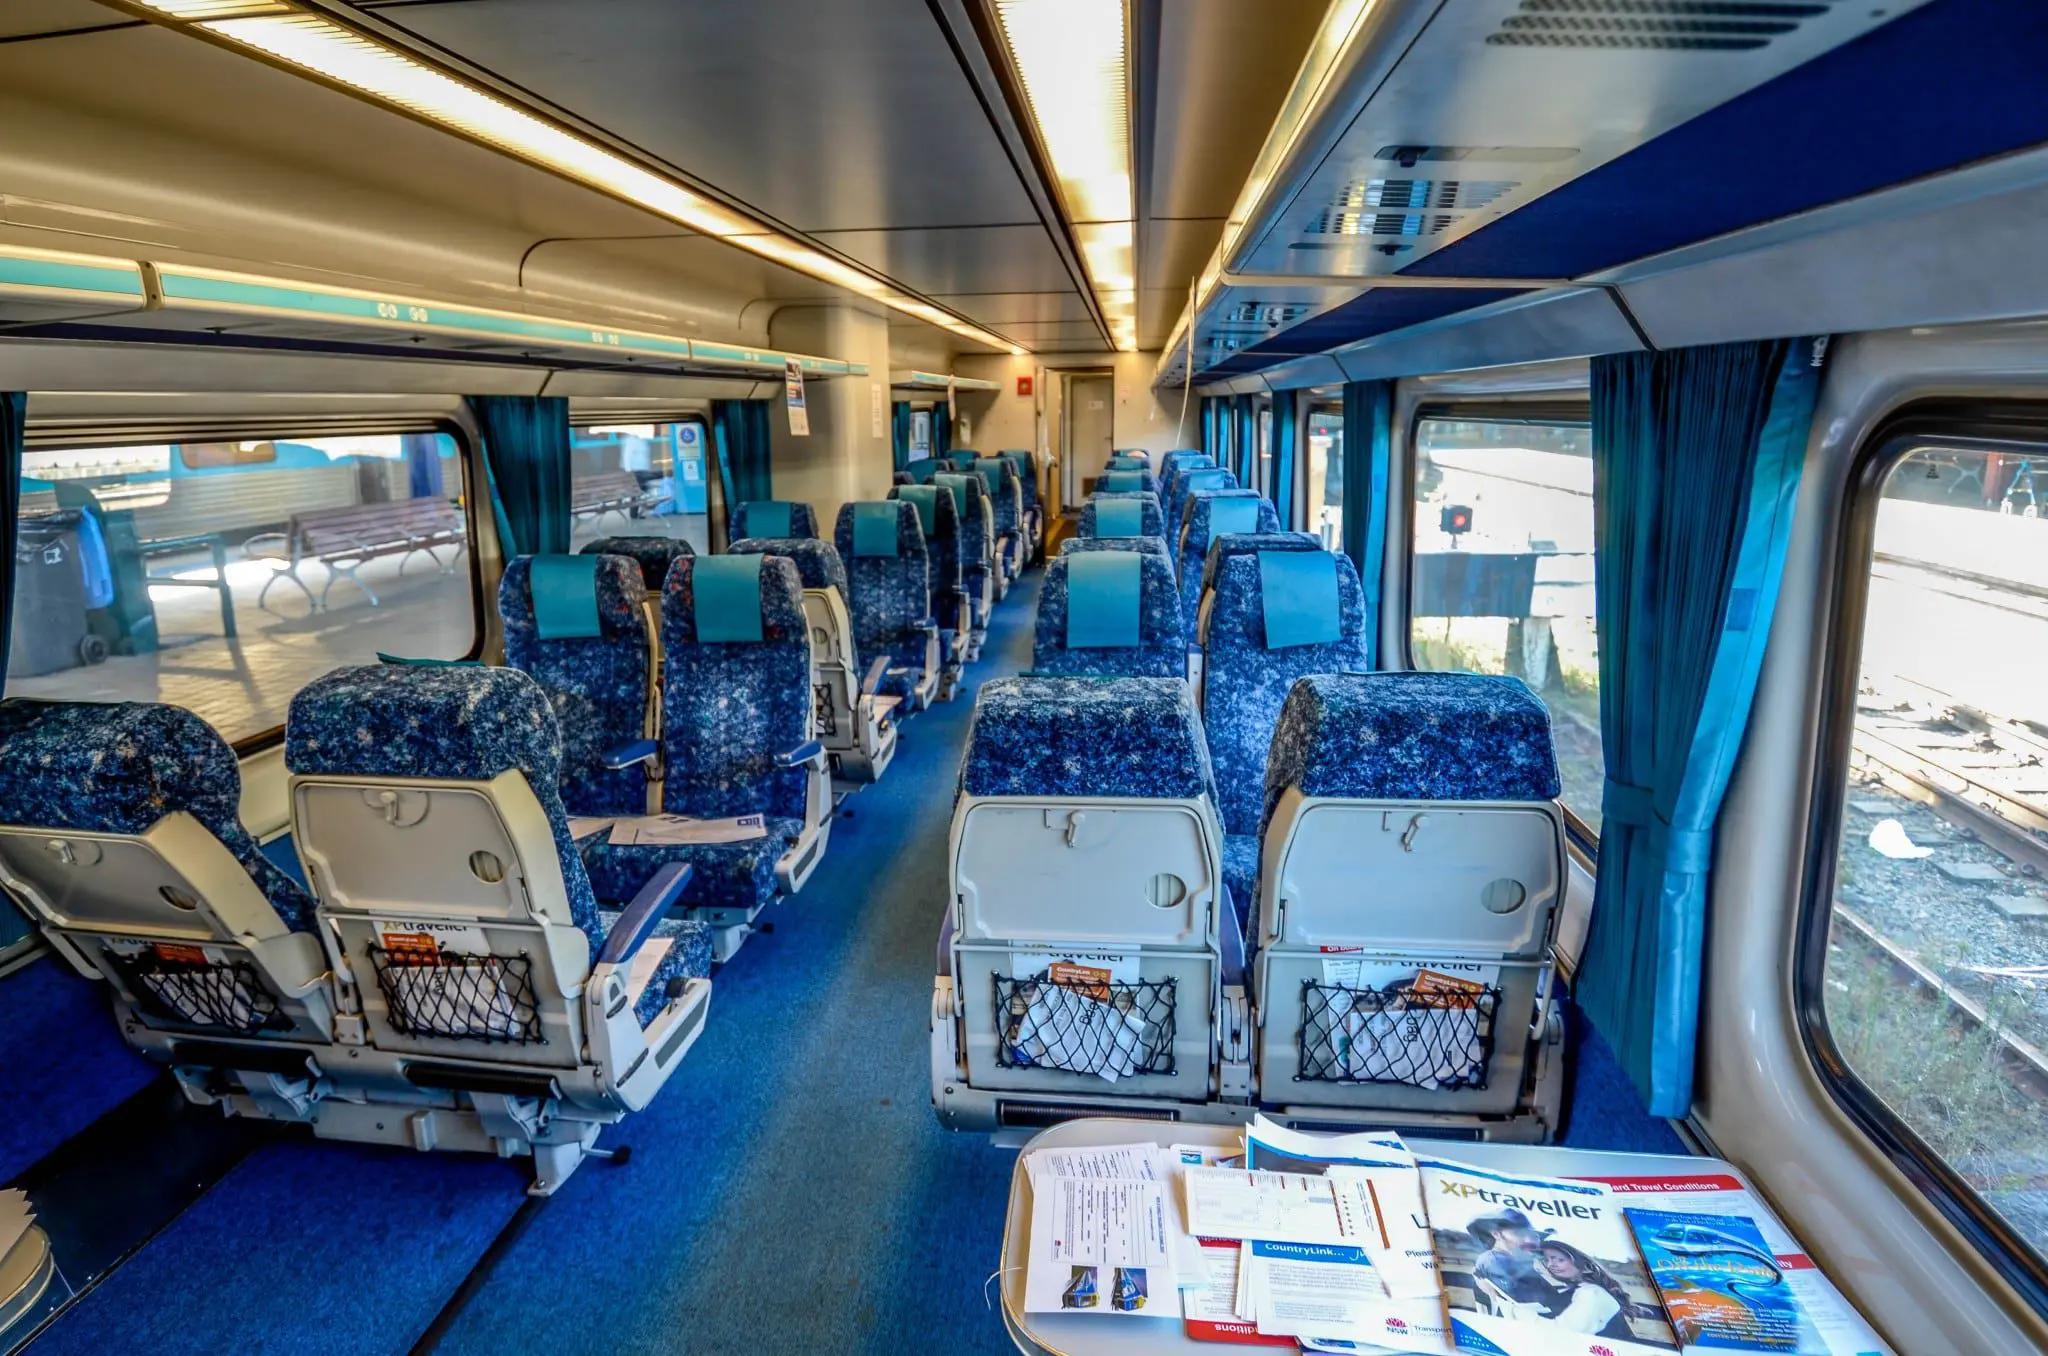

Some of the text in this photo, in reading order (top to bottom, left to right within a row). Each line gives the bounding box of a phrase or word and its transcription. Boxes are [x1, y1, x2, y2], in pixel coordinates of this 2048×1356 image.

[1633, 1183, 1662, 1191] Travel
[1664, 1182, 1720, 1190] Conditions
[1440, 1179, 1602, 1220] XPtraveller
[1387, 1326, 1408, 1335] NSW
